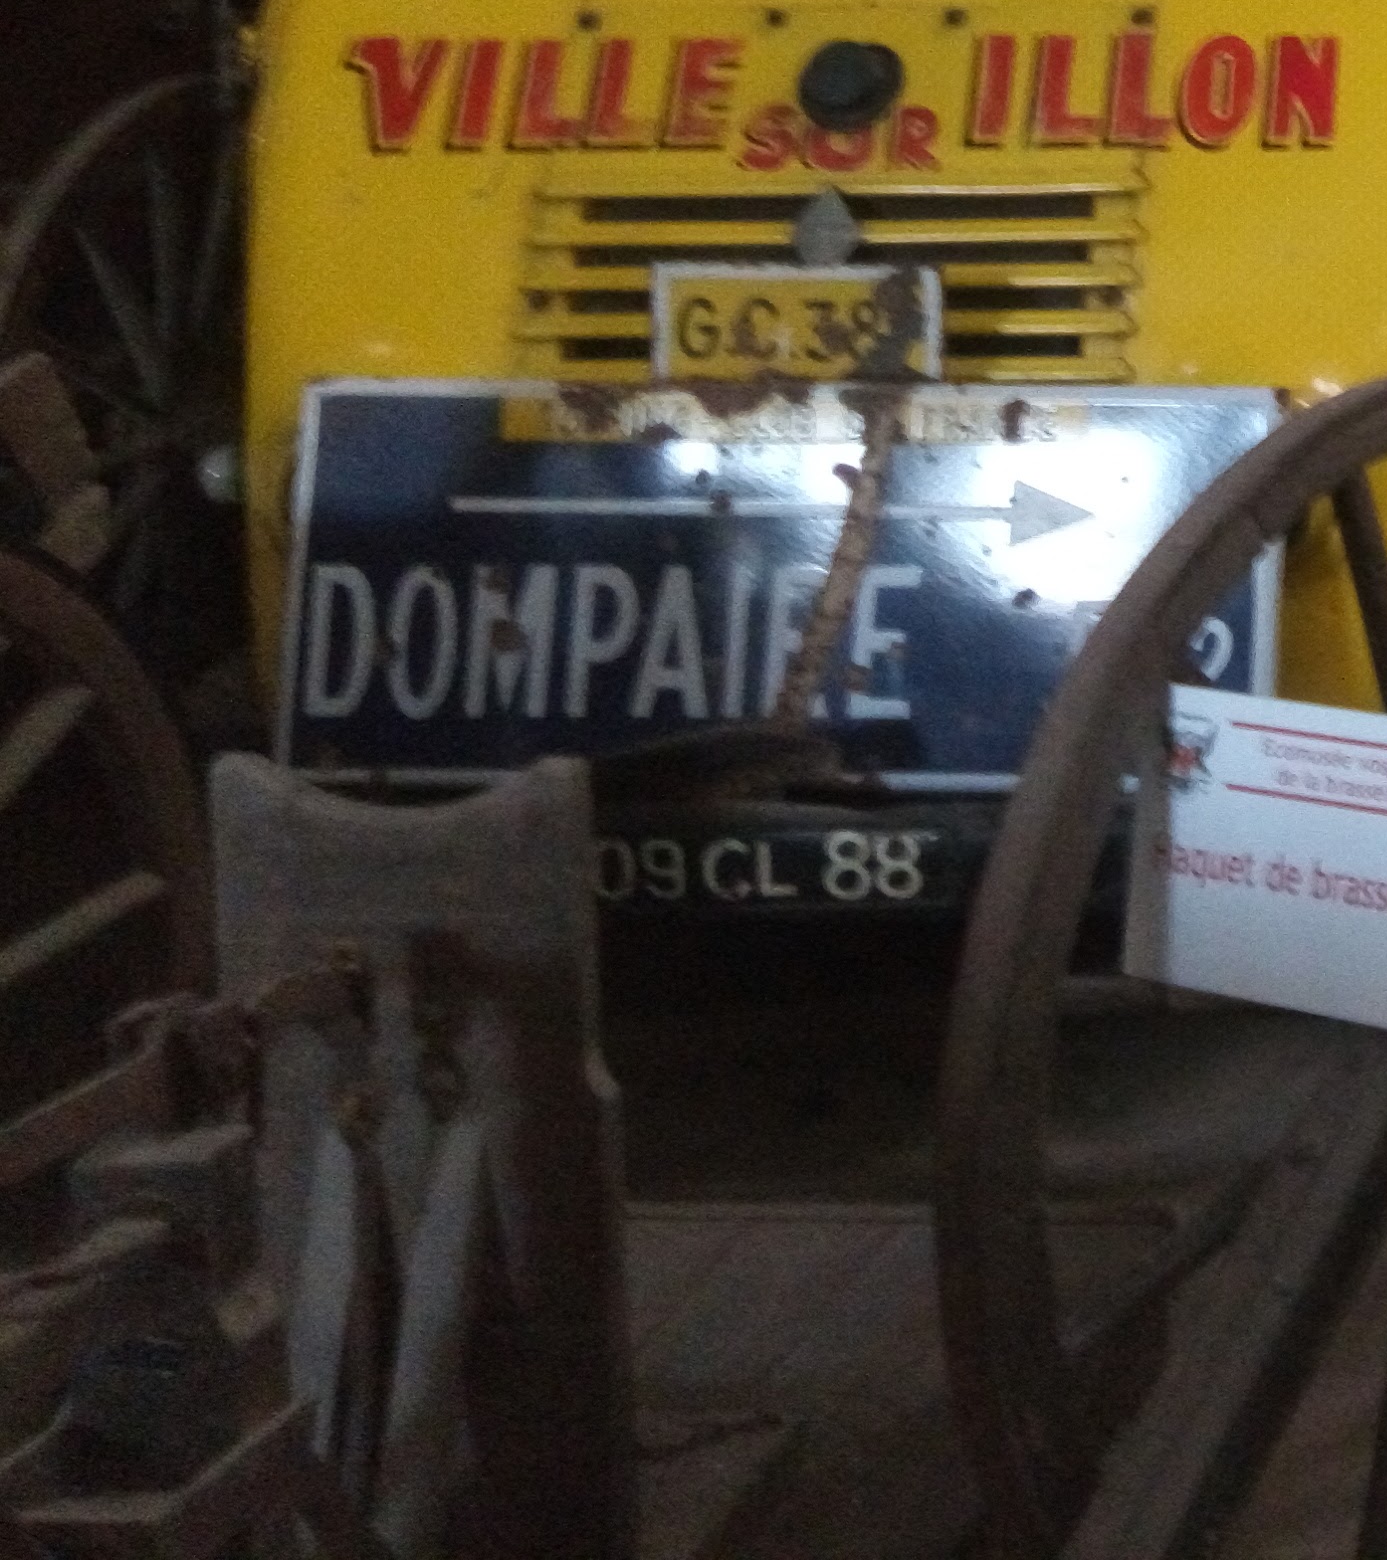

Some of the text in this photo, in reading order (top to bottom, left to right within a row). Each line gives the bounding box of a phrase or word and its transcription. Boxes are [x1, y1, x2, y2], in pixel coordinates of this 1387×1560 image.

[346, 32, 742, 153] VILLE
[965, 30, 1343, 154] ILLON
[302, 561, 923, 721] DOMPAIRE
[699, 836, 800, 901] CL
[819, 828, 925, 901] 88
[1265, 852, 1303, 895] de
